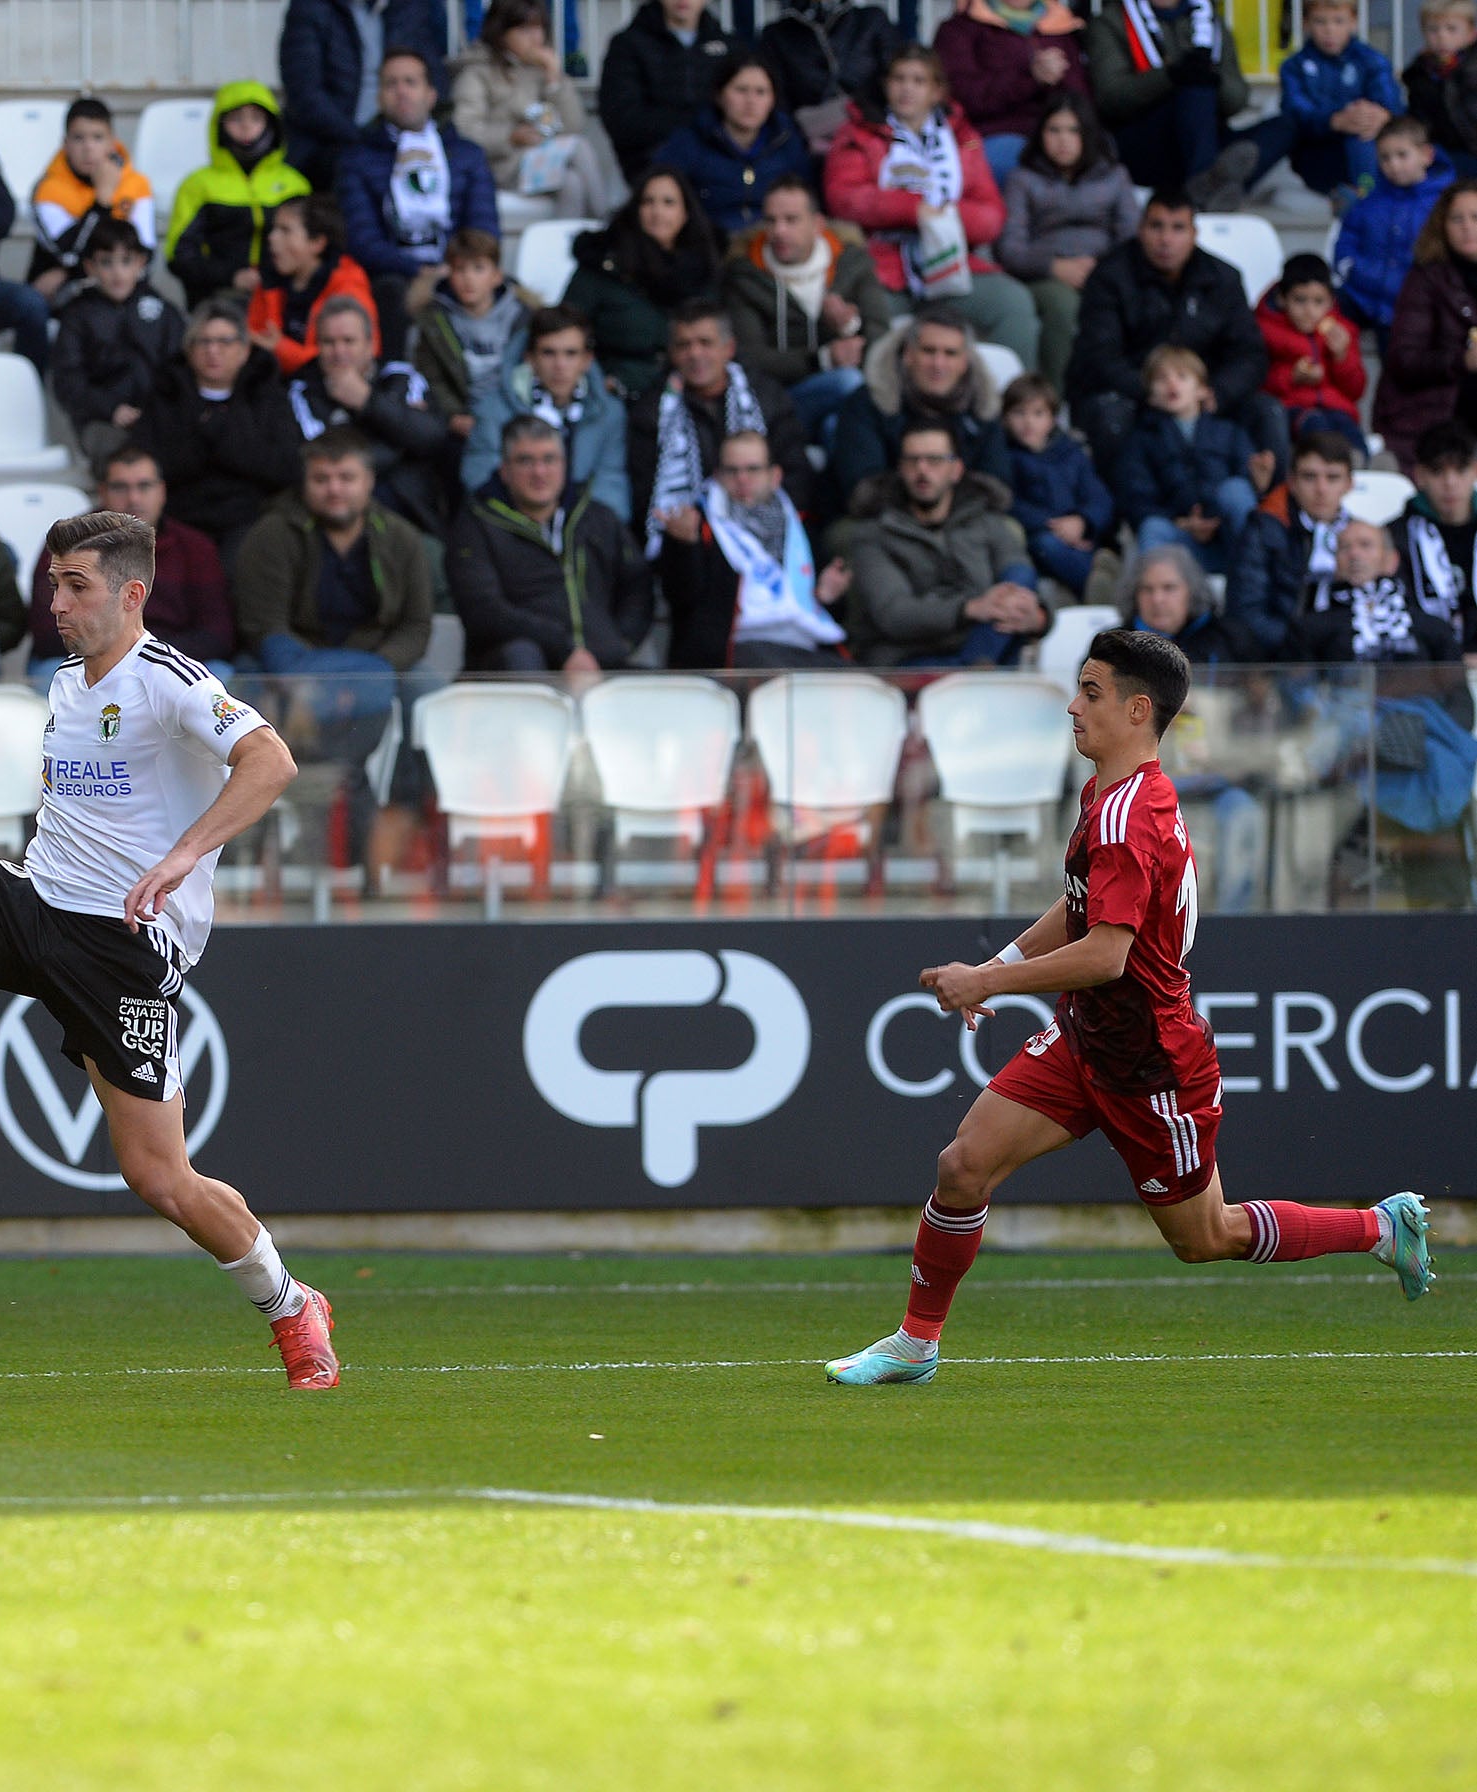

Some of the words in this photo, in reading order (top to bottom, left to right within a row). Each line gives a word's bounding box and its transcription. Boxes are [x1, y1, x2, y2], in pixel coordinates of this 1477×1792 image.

[56, 760, 130, 780] REALE
[56, 782, 132, 797] SEGUROS
[120, 997, 166, 1009] FUNDACIÓN
[119, 1005, 149, 1018] CAJA
[149, 1008, 166, 1019] DE
[131, 1071, 158, 1084] adidas
